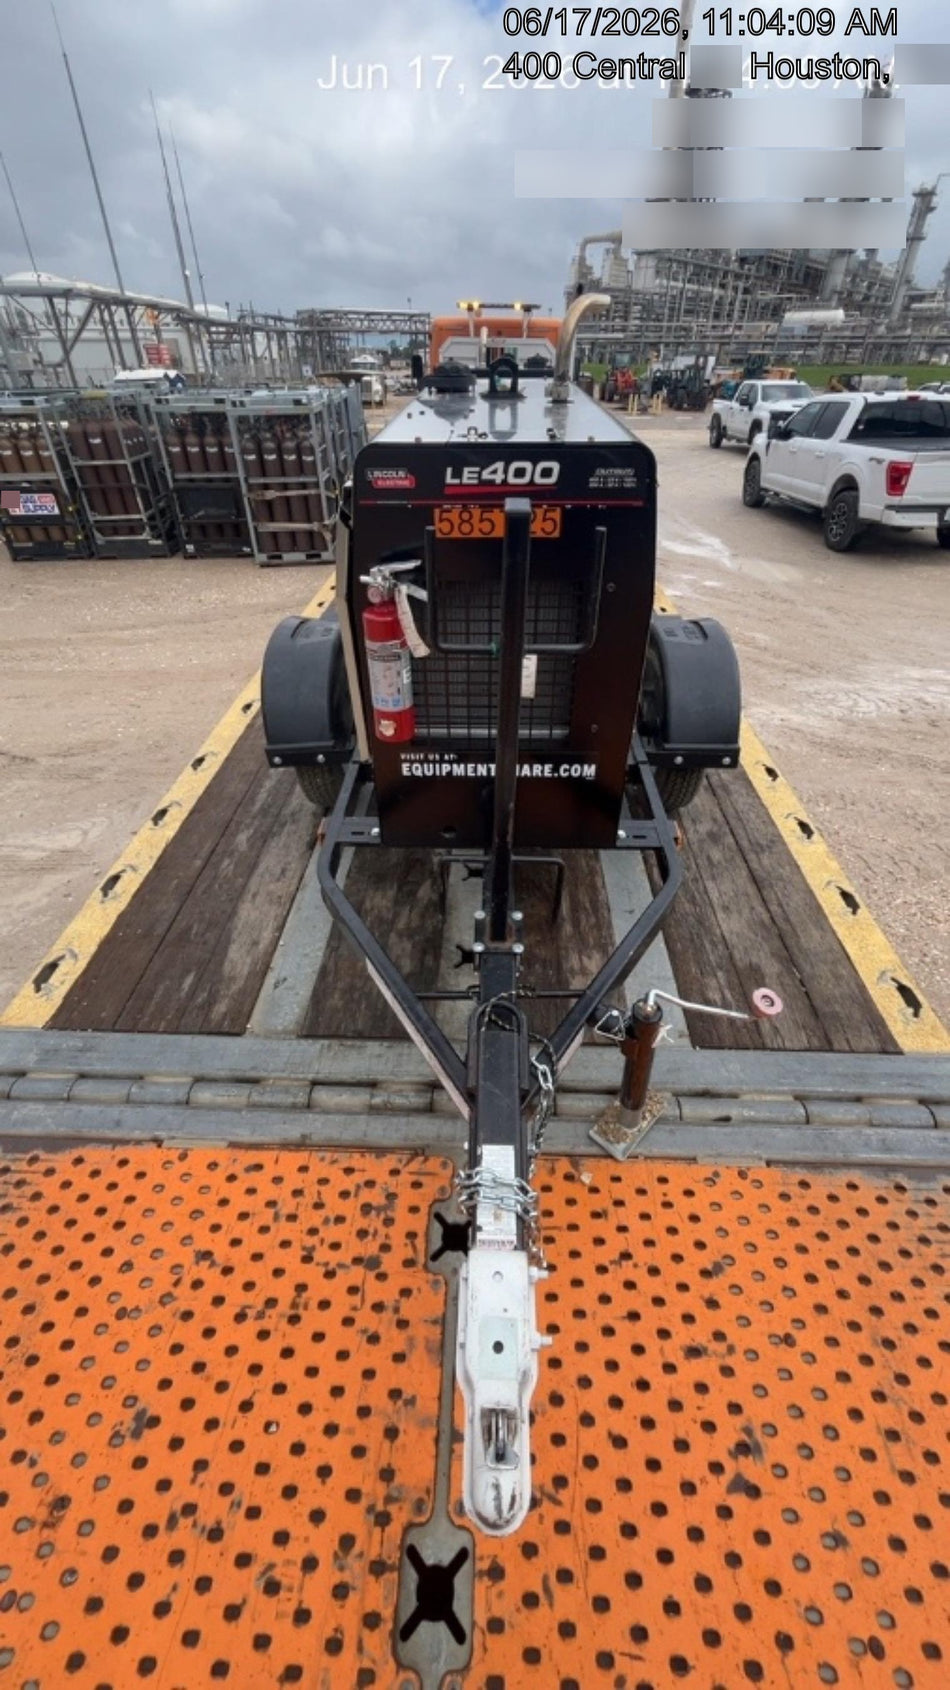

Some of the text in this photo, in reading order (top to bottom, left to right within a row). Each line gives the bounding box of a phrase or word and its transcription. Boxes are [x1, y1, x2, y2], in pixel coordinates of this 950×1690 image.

[445, 461, 560, 485] LE400
[438, 510, 558, 536] 5855
[400, 753, 425, 761] VISIT
[428, 753, 440, 761] US
[401, 763, 597, 778] EQUIPMENTARE.COM
